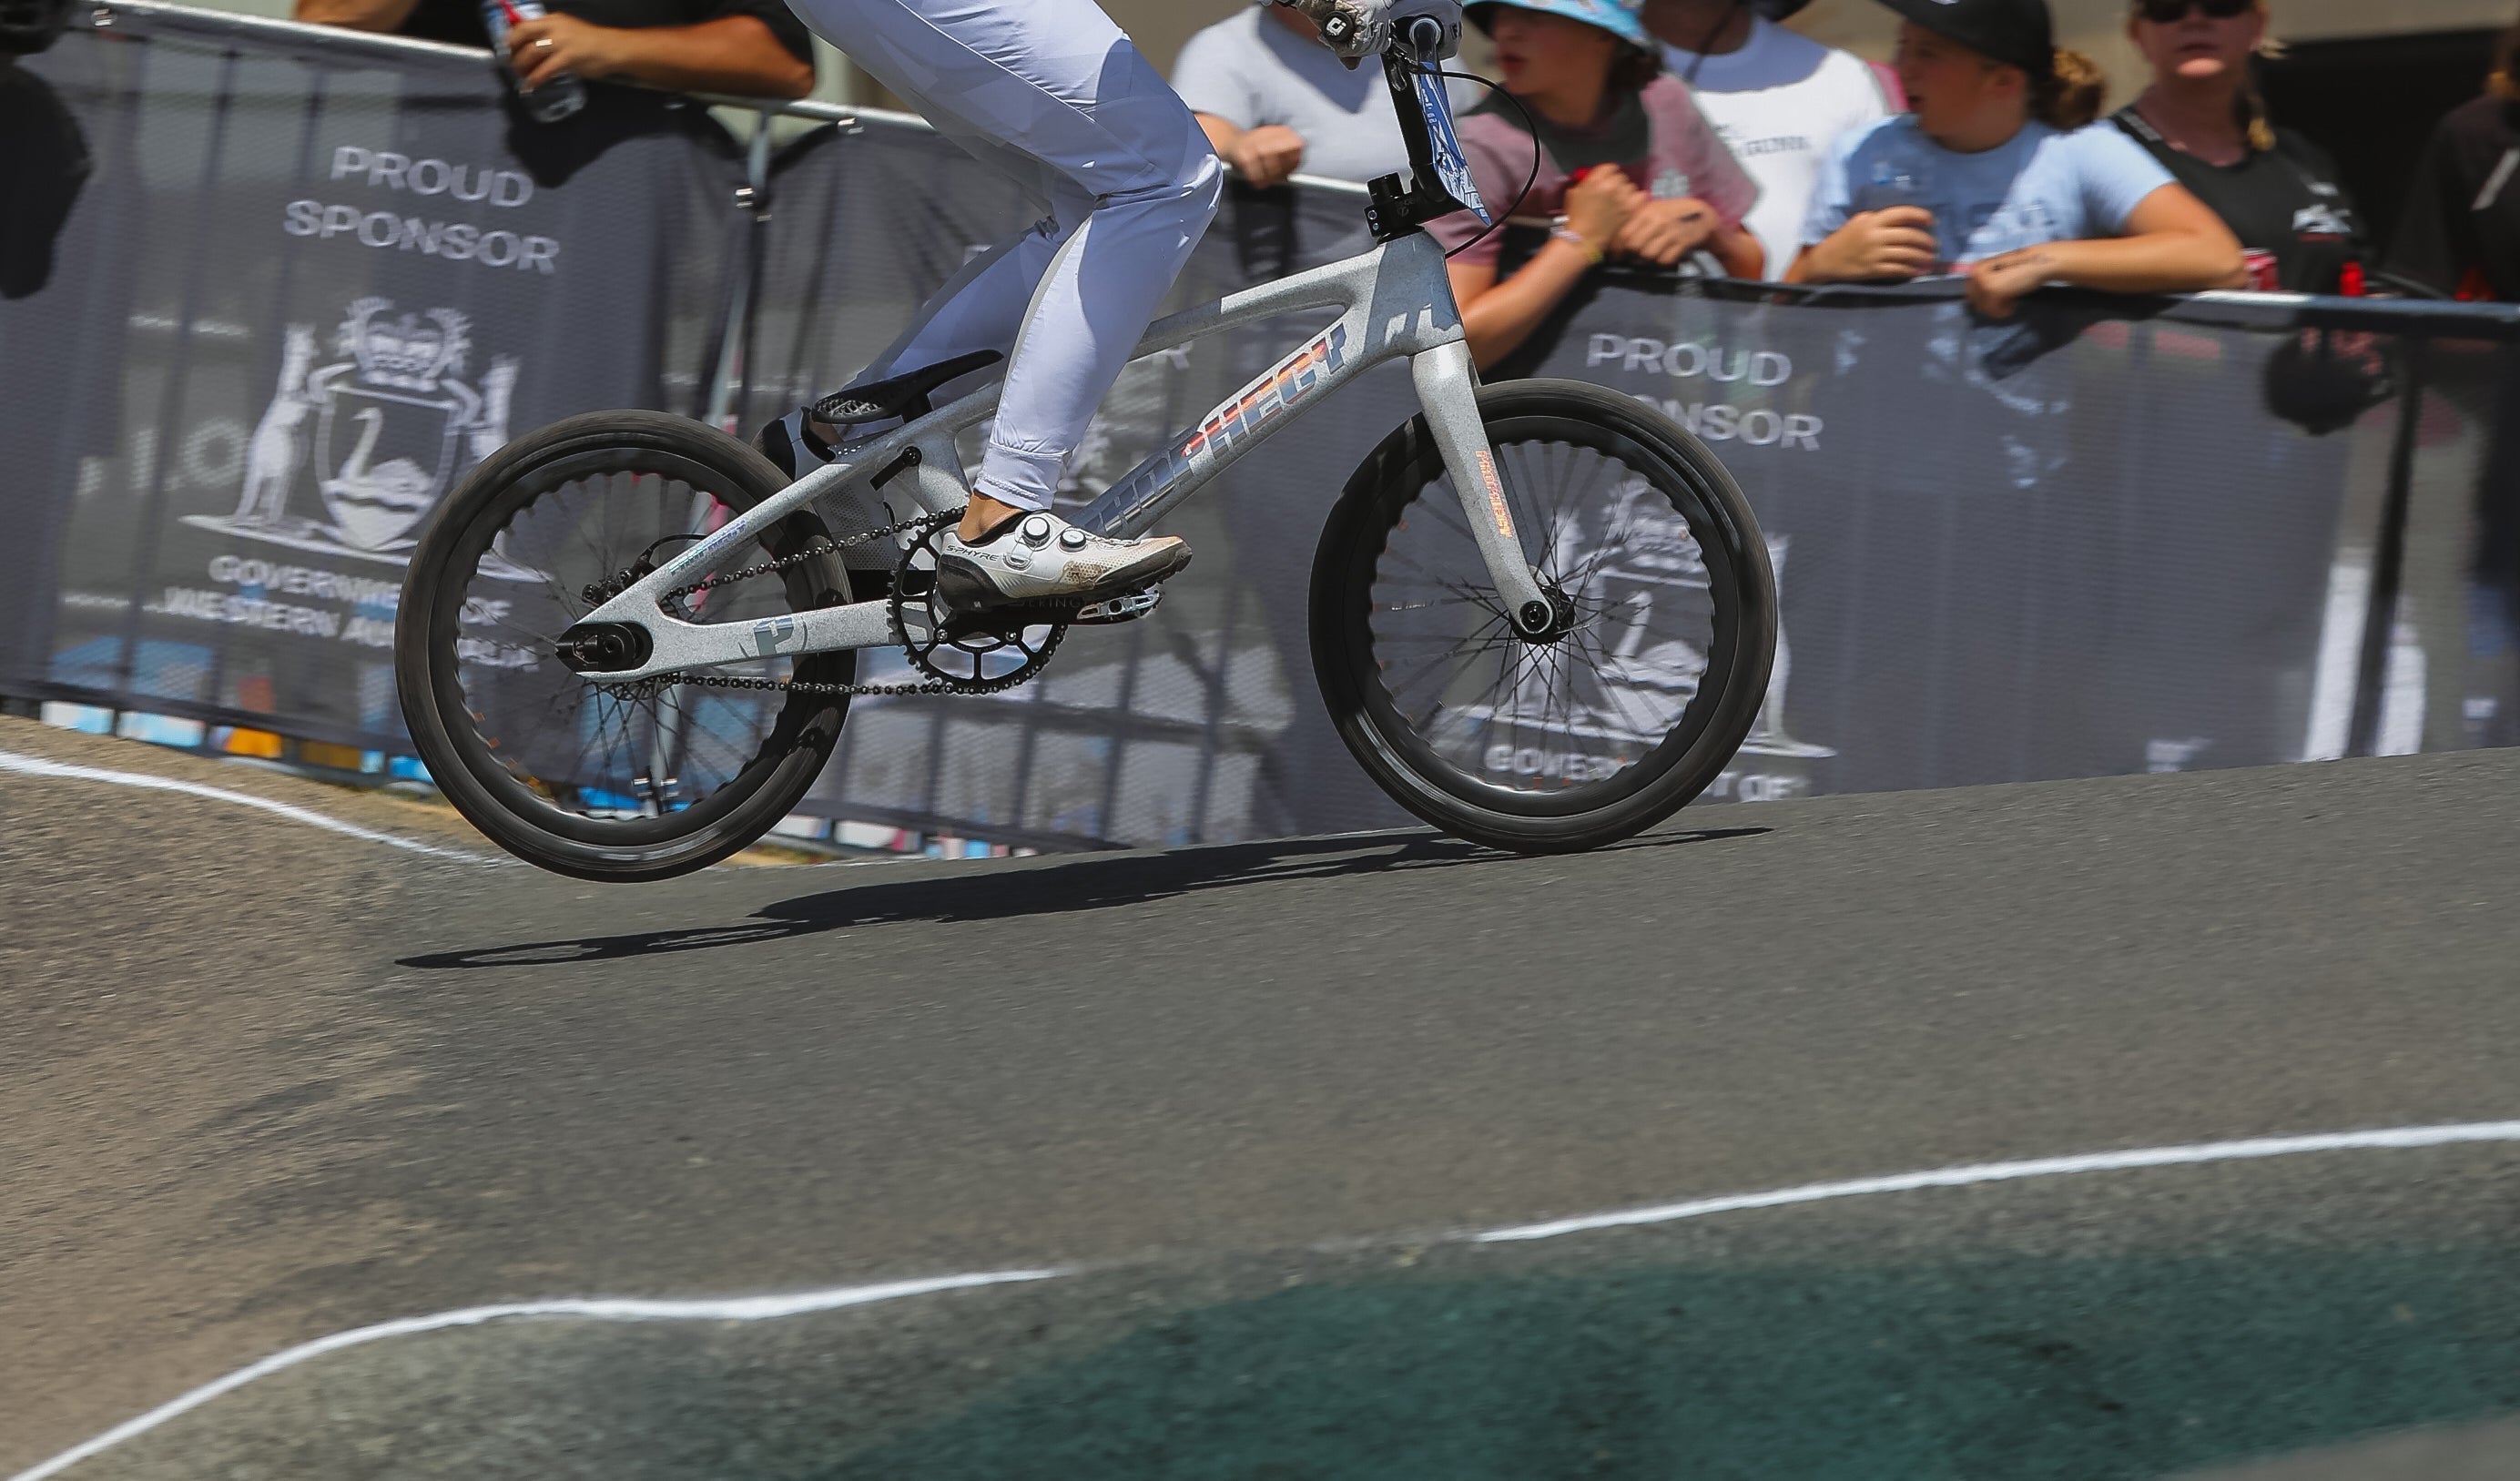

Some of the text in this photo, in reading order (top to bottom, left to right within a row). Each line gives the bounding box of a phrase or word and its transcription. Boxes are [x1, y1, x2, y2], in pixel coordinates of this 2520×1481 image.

[330, 146, 533, 208] PROUD
[283, 199, 561, 274] SPONSOR
[1586, 333, 1792, 387] PROUD
[1632, 394, 1823, 452] NSOR
[208, 553, 401, 604] GOVERNME
